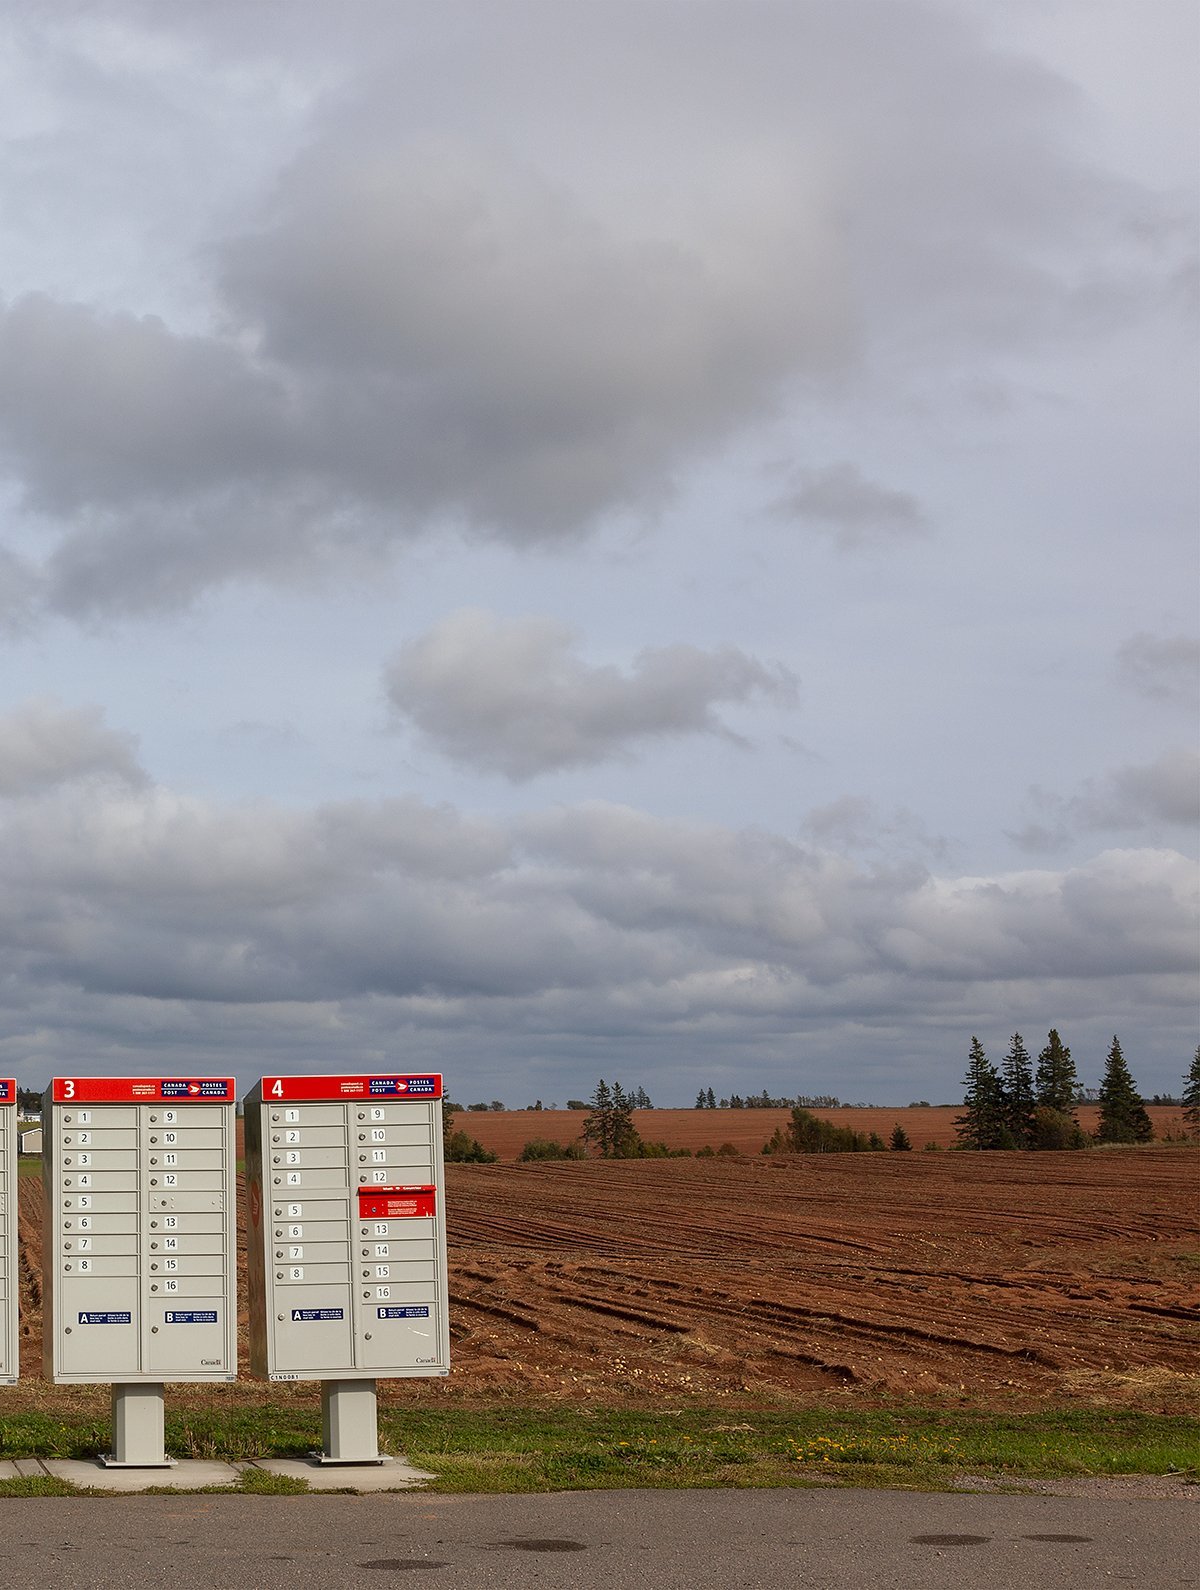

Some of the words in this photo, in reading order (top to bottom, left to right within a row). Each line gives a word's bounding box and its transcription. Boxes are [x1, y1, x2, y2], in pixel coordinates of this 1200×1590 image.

[64, 1080, 75, 1098] 3
[271, 1080, 284, 1098] 4
[167, 1112, 173, 1121] 9
[374, 1109, 381, 1119] 9
[81, 1133, 87, 1143] 2
[166, 1133, 175, 1142] 10
[290, 1132, 296, 1141] 2
[373, 1130, 385, 1140] 10
[82, 1154, 88, 1164] 3
[167, 1154, 175, 1163] 11
[291, 1153, 296, 1163] 3
[374, 1152, 384, 1161] 11
[81, 1176, 87, 1184] 4
[166, 1175, 175, 1184] 12
[291, 1174, 297, 1183] 4
[375, 1172, 386, 1182] 12
[81, 1197, 87, 1206] 5
[292, 1205, 298, 1215] 5
[81, 1218, 88, 1227] 6
[166, 1217, 176, 1227] 13
[292, 1226, 299, 1236] 6
[376, 1225, 387, 1234] 13
[82, 1239, 88, 1248] 7
[166, 1239, 176, 1248] 14
[293, 1248, 299, 1257] 7
[377, 1246, 388, 1255] 14
[81, 1260, 88, 1270] 8
[166, 1260, 176, 1269] 15
[293, 1268, 300, 1278] 8
[378, 1267, 388, 1276] 15
[166, 1280, 176, 1290] 16
[378, 1288, 389, 1297] 16
[80, 1313, 88, 1323] A
[167, 1313, 173, 1322] B
[294, 1310, 301, 1320] A
[380, 1309, 386, 1318] B
